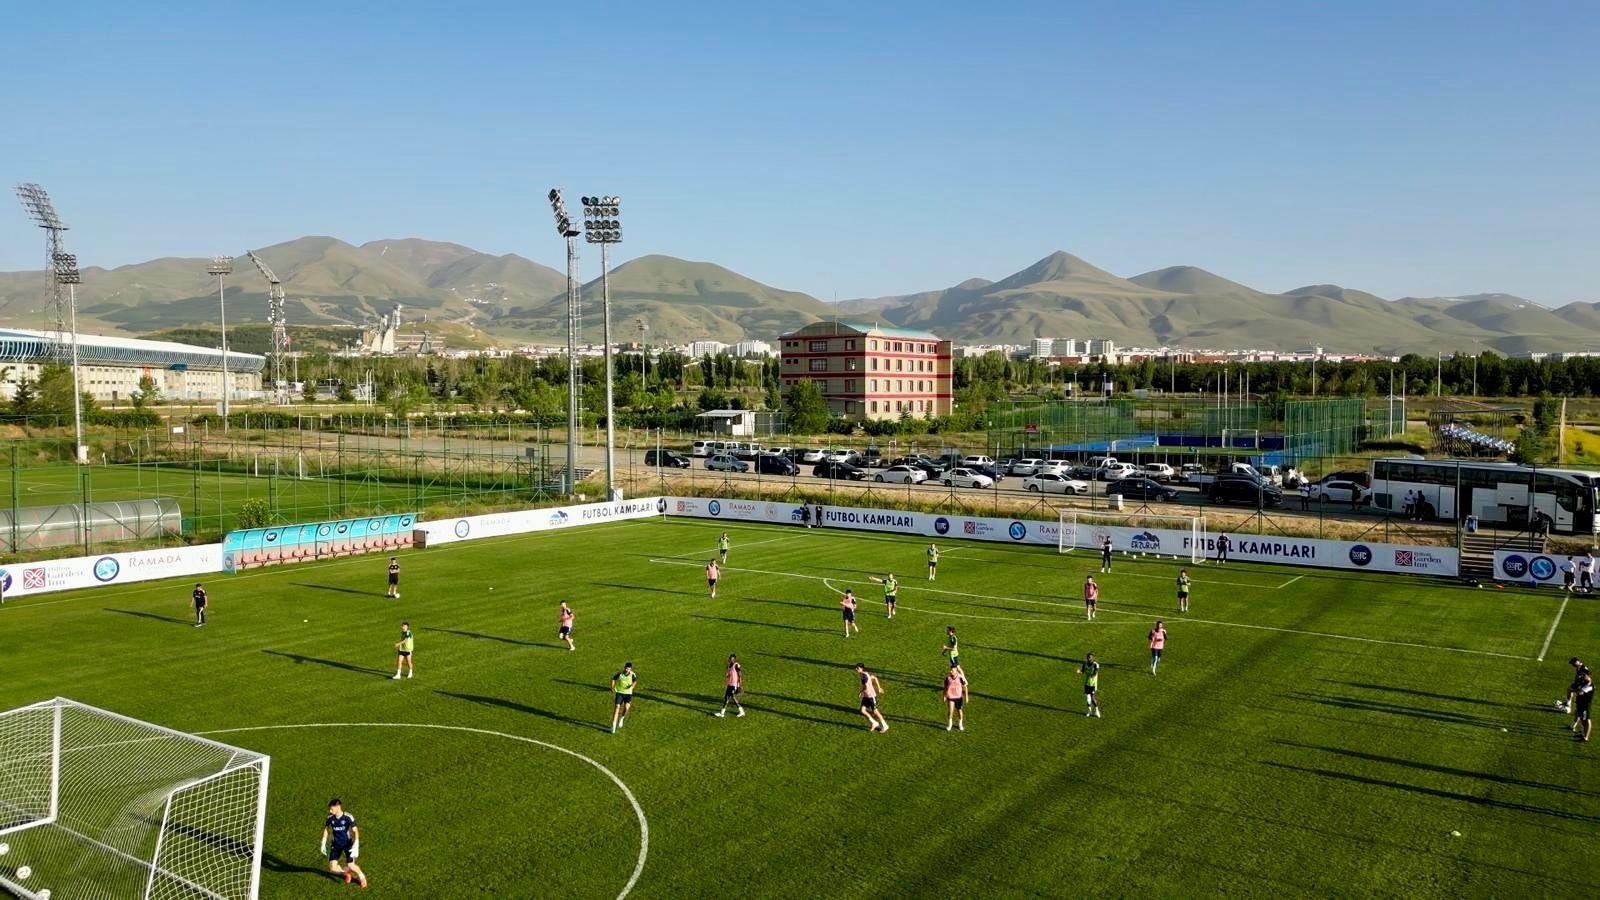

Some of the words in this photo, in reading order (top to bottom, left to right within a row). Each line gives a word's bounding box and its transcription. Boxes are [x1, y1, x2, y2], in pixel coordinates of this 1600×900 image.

[582, 507, 612, 519] FUTBOL
[614, 503, 653, 515] KAMPLARI
[729, 502, 756, 511] RAMADA
[826, 511, 860, 523] FUTBOL
[863, 514, 914, 527] KAMPLARI
[1131, 541, 1160, 550] ERZURUM
[1183, 537, 1234, 552] FUTBL
[1239, 541, 1316, 558] KAMPLARI
[129, 555, 182, 568] RAMADA
[1414, 556, 1442, 564] Garden
